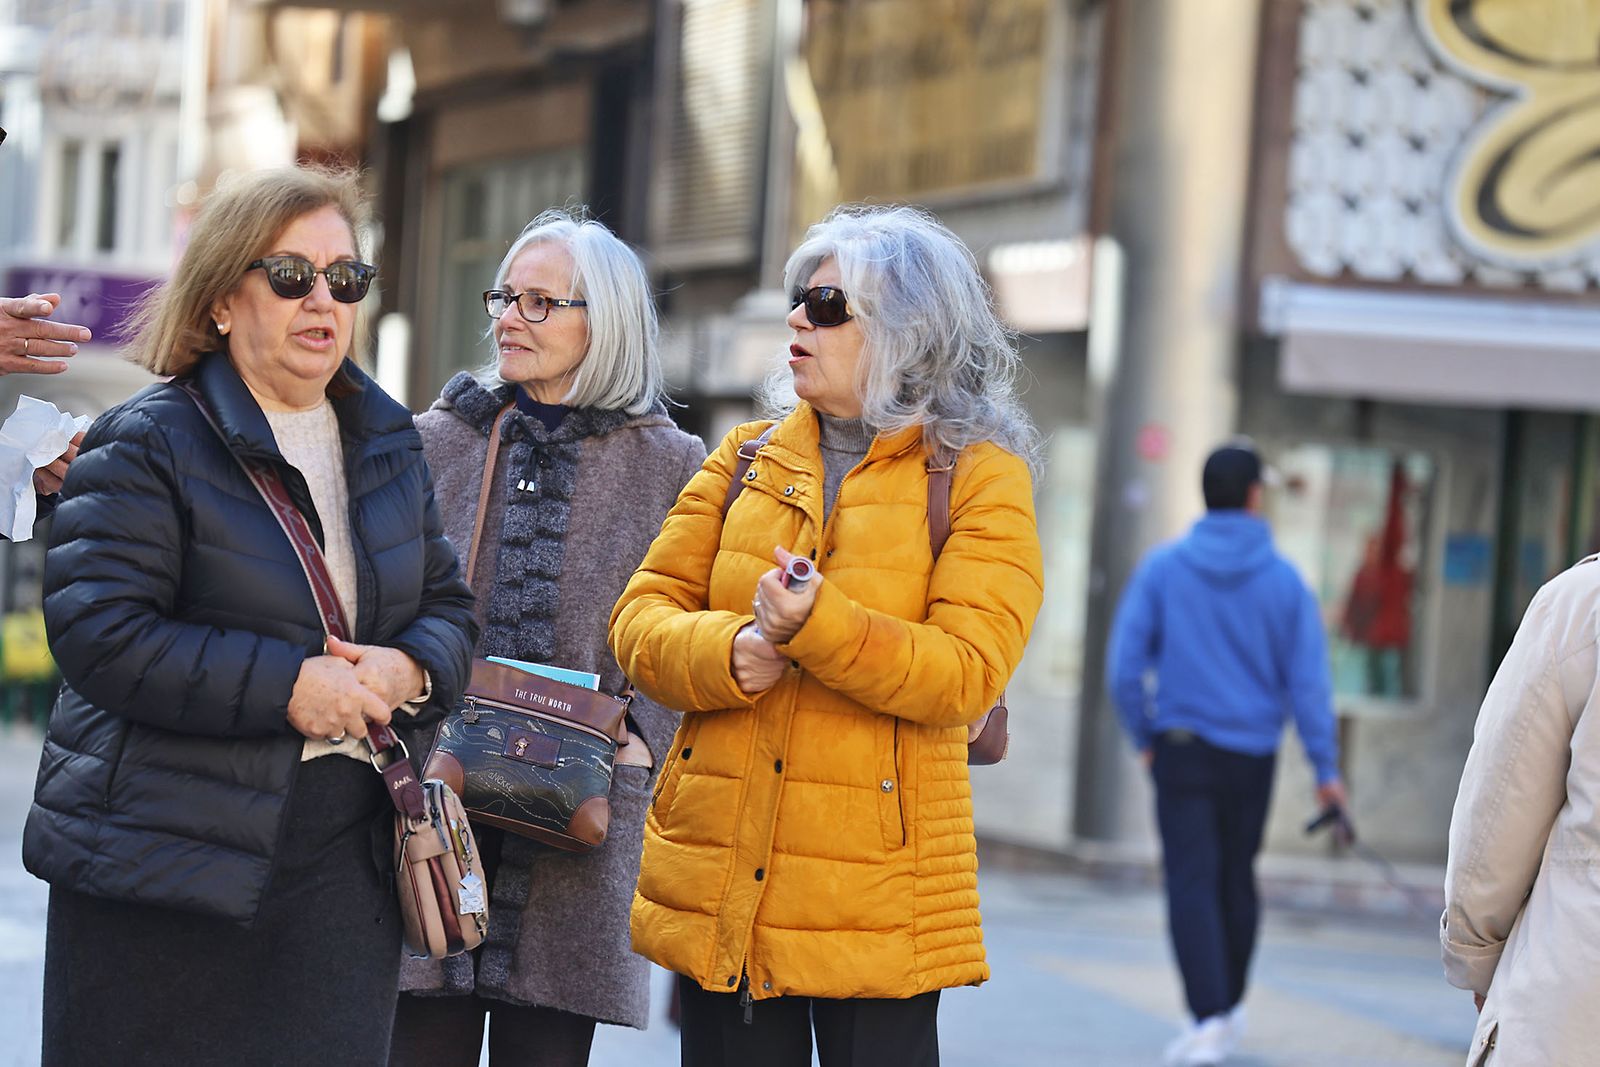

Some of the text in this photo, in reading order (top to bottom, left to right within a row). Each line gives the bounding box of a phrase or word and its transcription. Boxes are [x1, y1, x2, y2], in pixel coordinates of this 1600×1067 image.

[514, 688, 572, 713] THE TRUE NORTH
